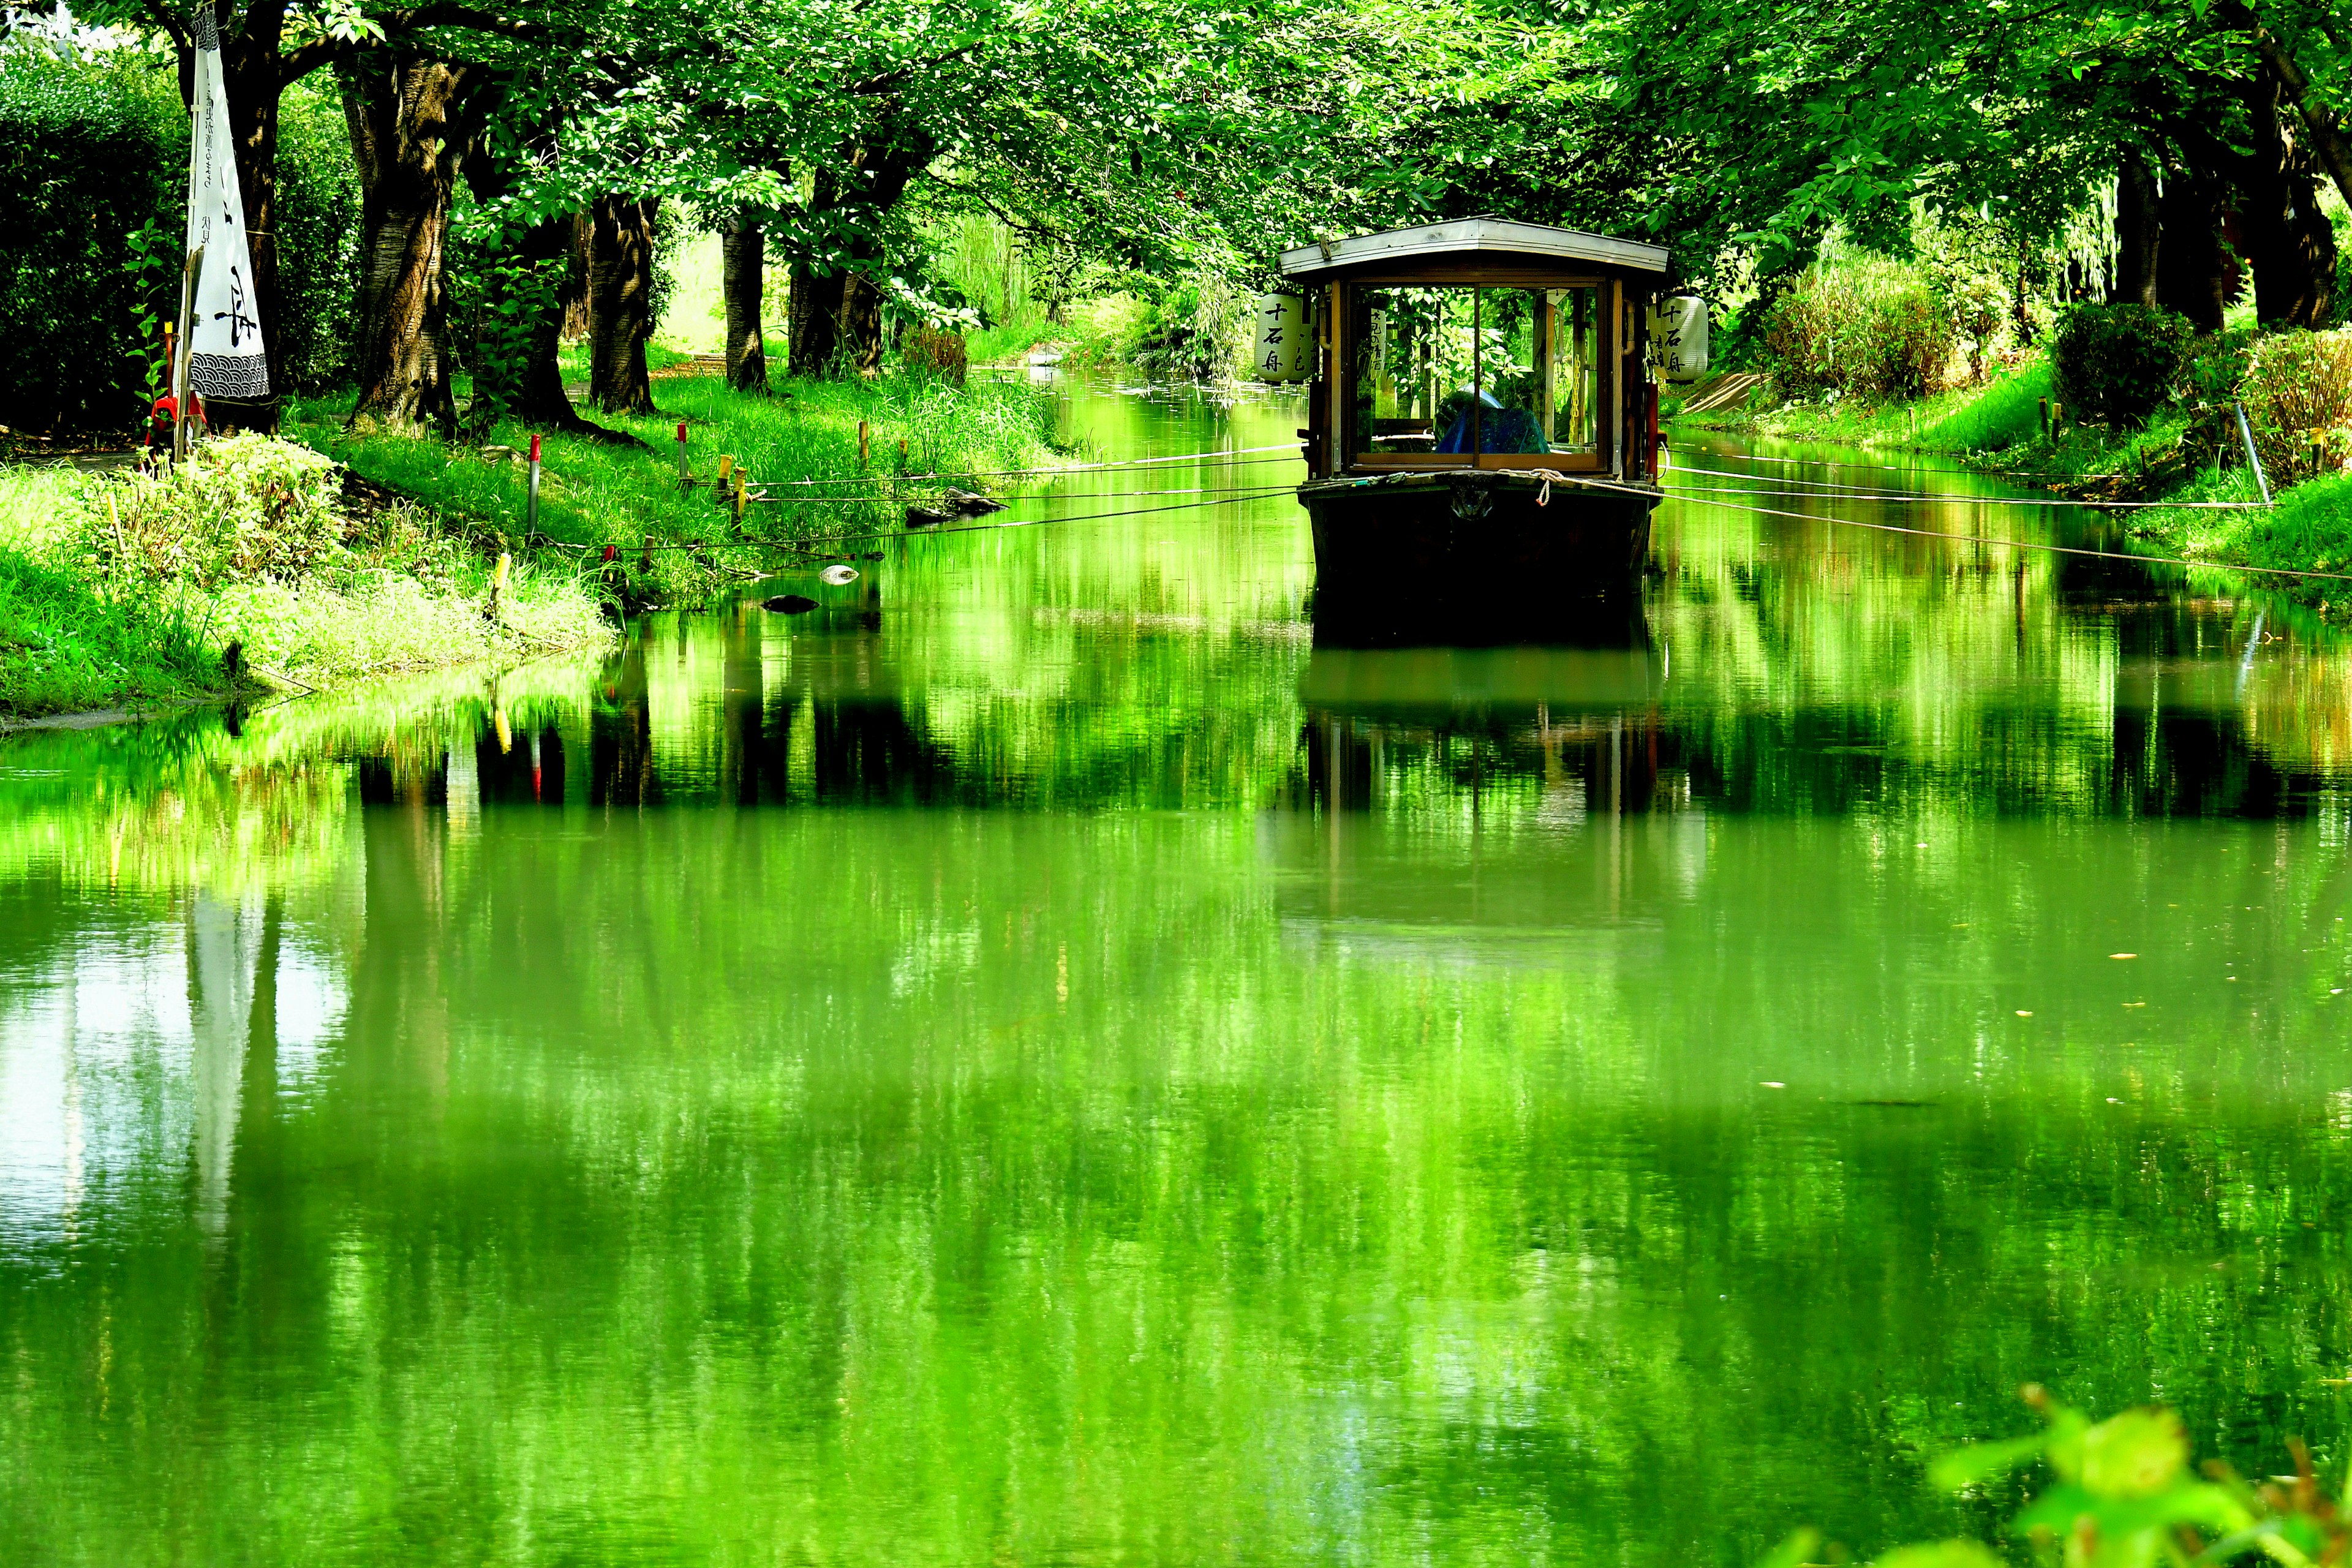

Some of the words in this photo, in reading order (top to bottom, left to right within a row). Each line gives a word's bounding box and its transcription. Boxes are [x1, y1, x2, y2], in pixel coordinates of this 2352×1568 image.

[1262, 303, 1288, 372] 十石舟
[1662, 305, 1685, 372] 十石舟
